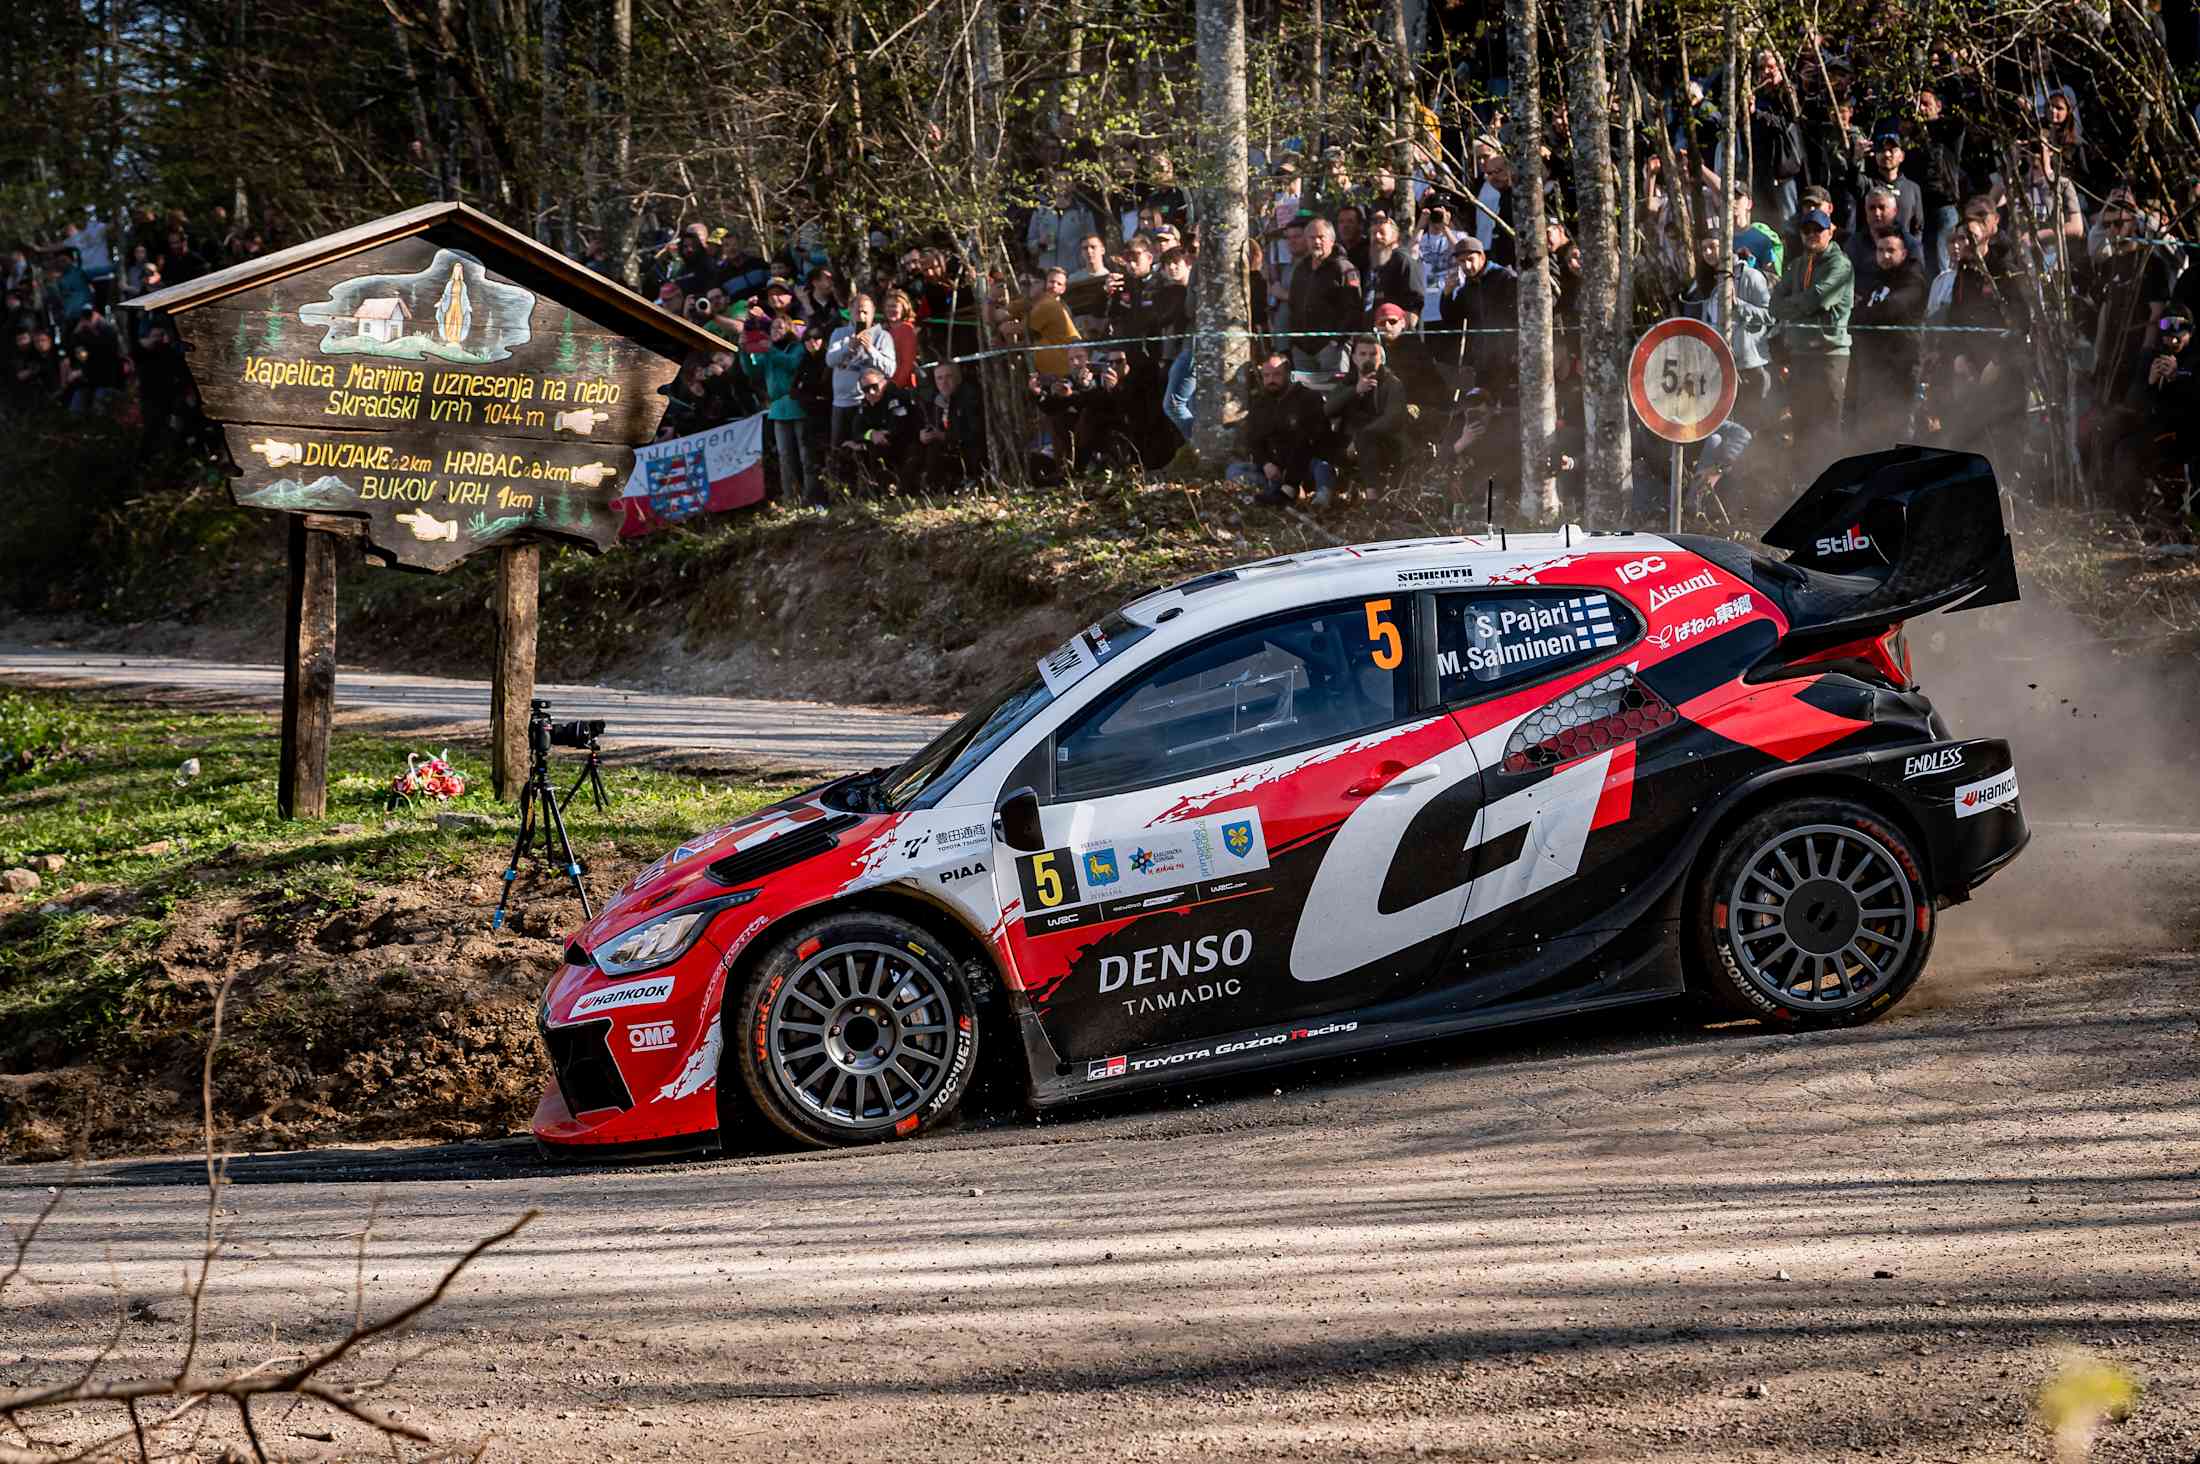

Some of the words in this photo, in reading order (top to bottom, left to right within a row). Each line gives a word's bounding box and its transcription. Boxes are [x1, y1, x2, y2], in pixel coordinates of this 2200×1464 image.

[244, 356, 335, 389] Kapelica
[344, 362, 424, 394] Marijina
[541, 378, 567, 401] na
[573, 377, 621, 404] nebo
[324, 389, 421, 420] Skradski
[303, 442, 394, 470] DIVJAKE
[444, 450, 523, 478] HRIBAC
[360, 475, 438, 502] BUKOV
[448, 480, 490, 505] VRH
[1397, 568, 1473, 582] SCHROTH
[1364, 598, 1403, 670] 5
[1476, 601, 1569, 638] S.Pajari
[1437, 634, 1577, 677] M.Salminen
[1904, 746, 1963, 776] ENDLESS
[939, 862, 987, 884] PIAA
[1032, 852, 1064, 907] 5
[1047, 913, 1080, 927] WRC
[1098, 928, 1253, 993] DENSO
[1122, 978, 1242, 1016] TAMADIC
[629, 1025, 676, 1047] OMP
[1130, 1049, 1211, 1071] TOYOTA
[1214, 1034, 1287, 1055] GAZOO
[1290, 1021, 1358, 1041] Racing
